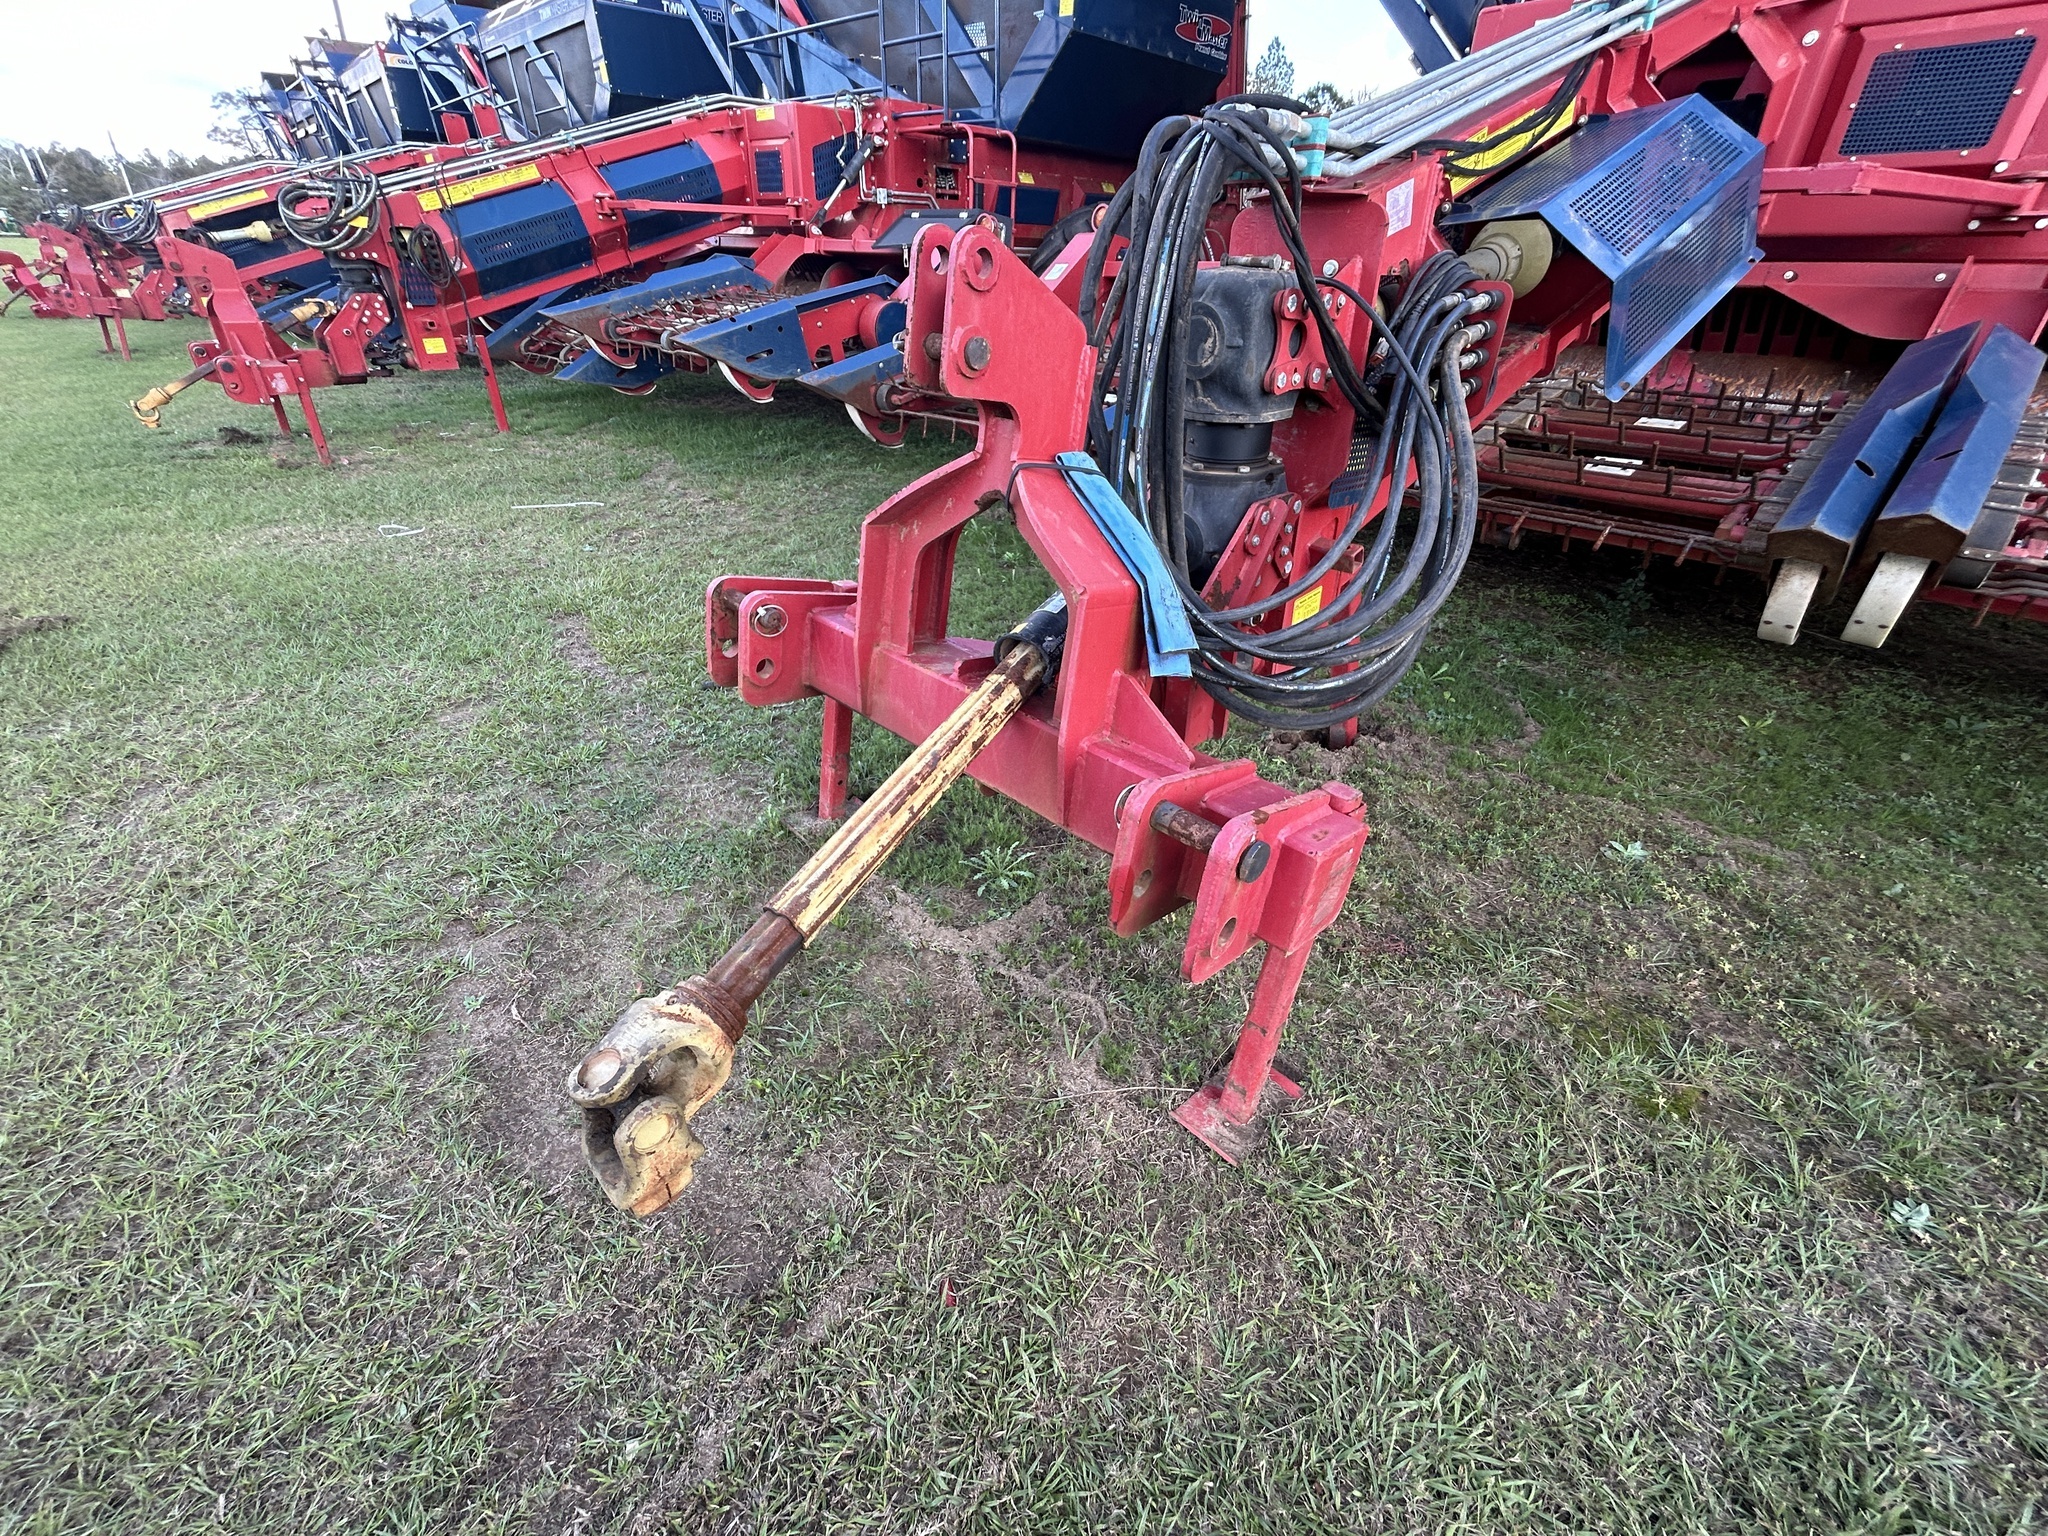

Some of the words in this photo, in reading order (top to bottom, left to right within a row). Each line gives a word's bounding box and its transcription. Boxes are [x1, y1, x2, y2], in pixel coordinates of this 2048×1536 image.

[661, 0, 688, 16] TWIN
[702, 7, 724, 22] STER
[1200, 24, 1228, 49] Master
